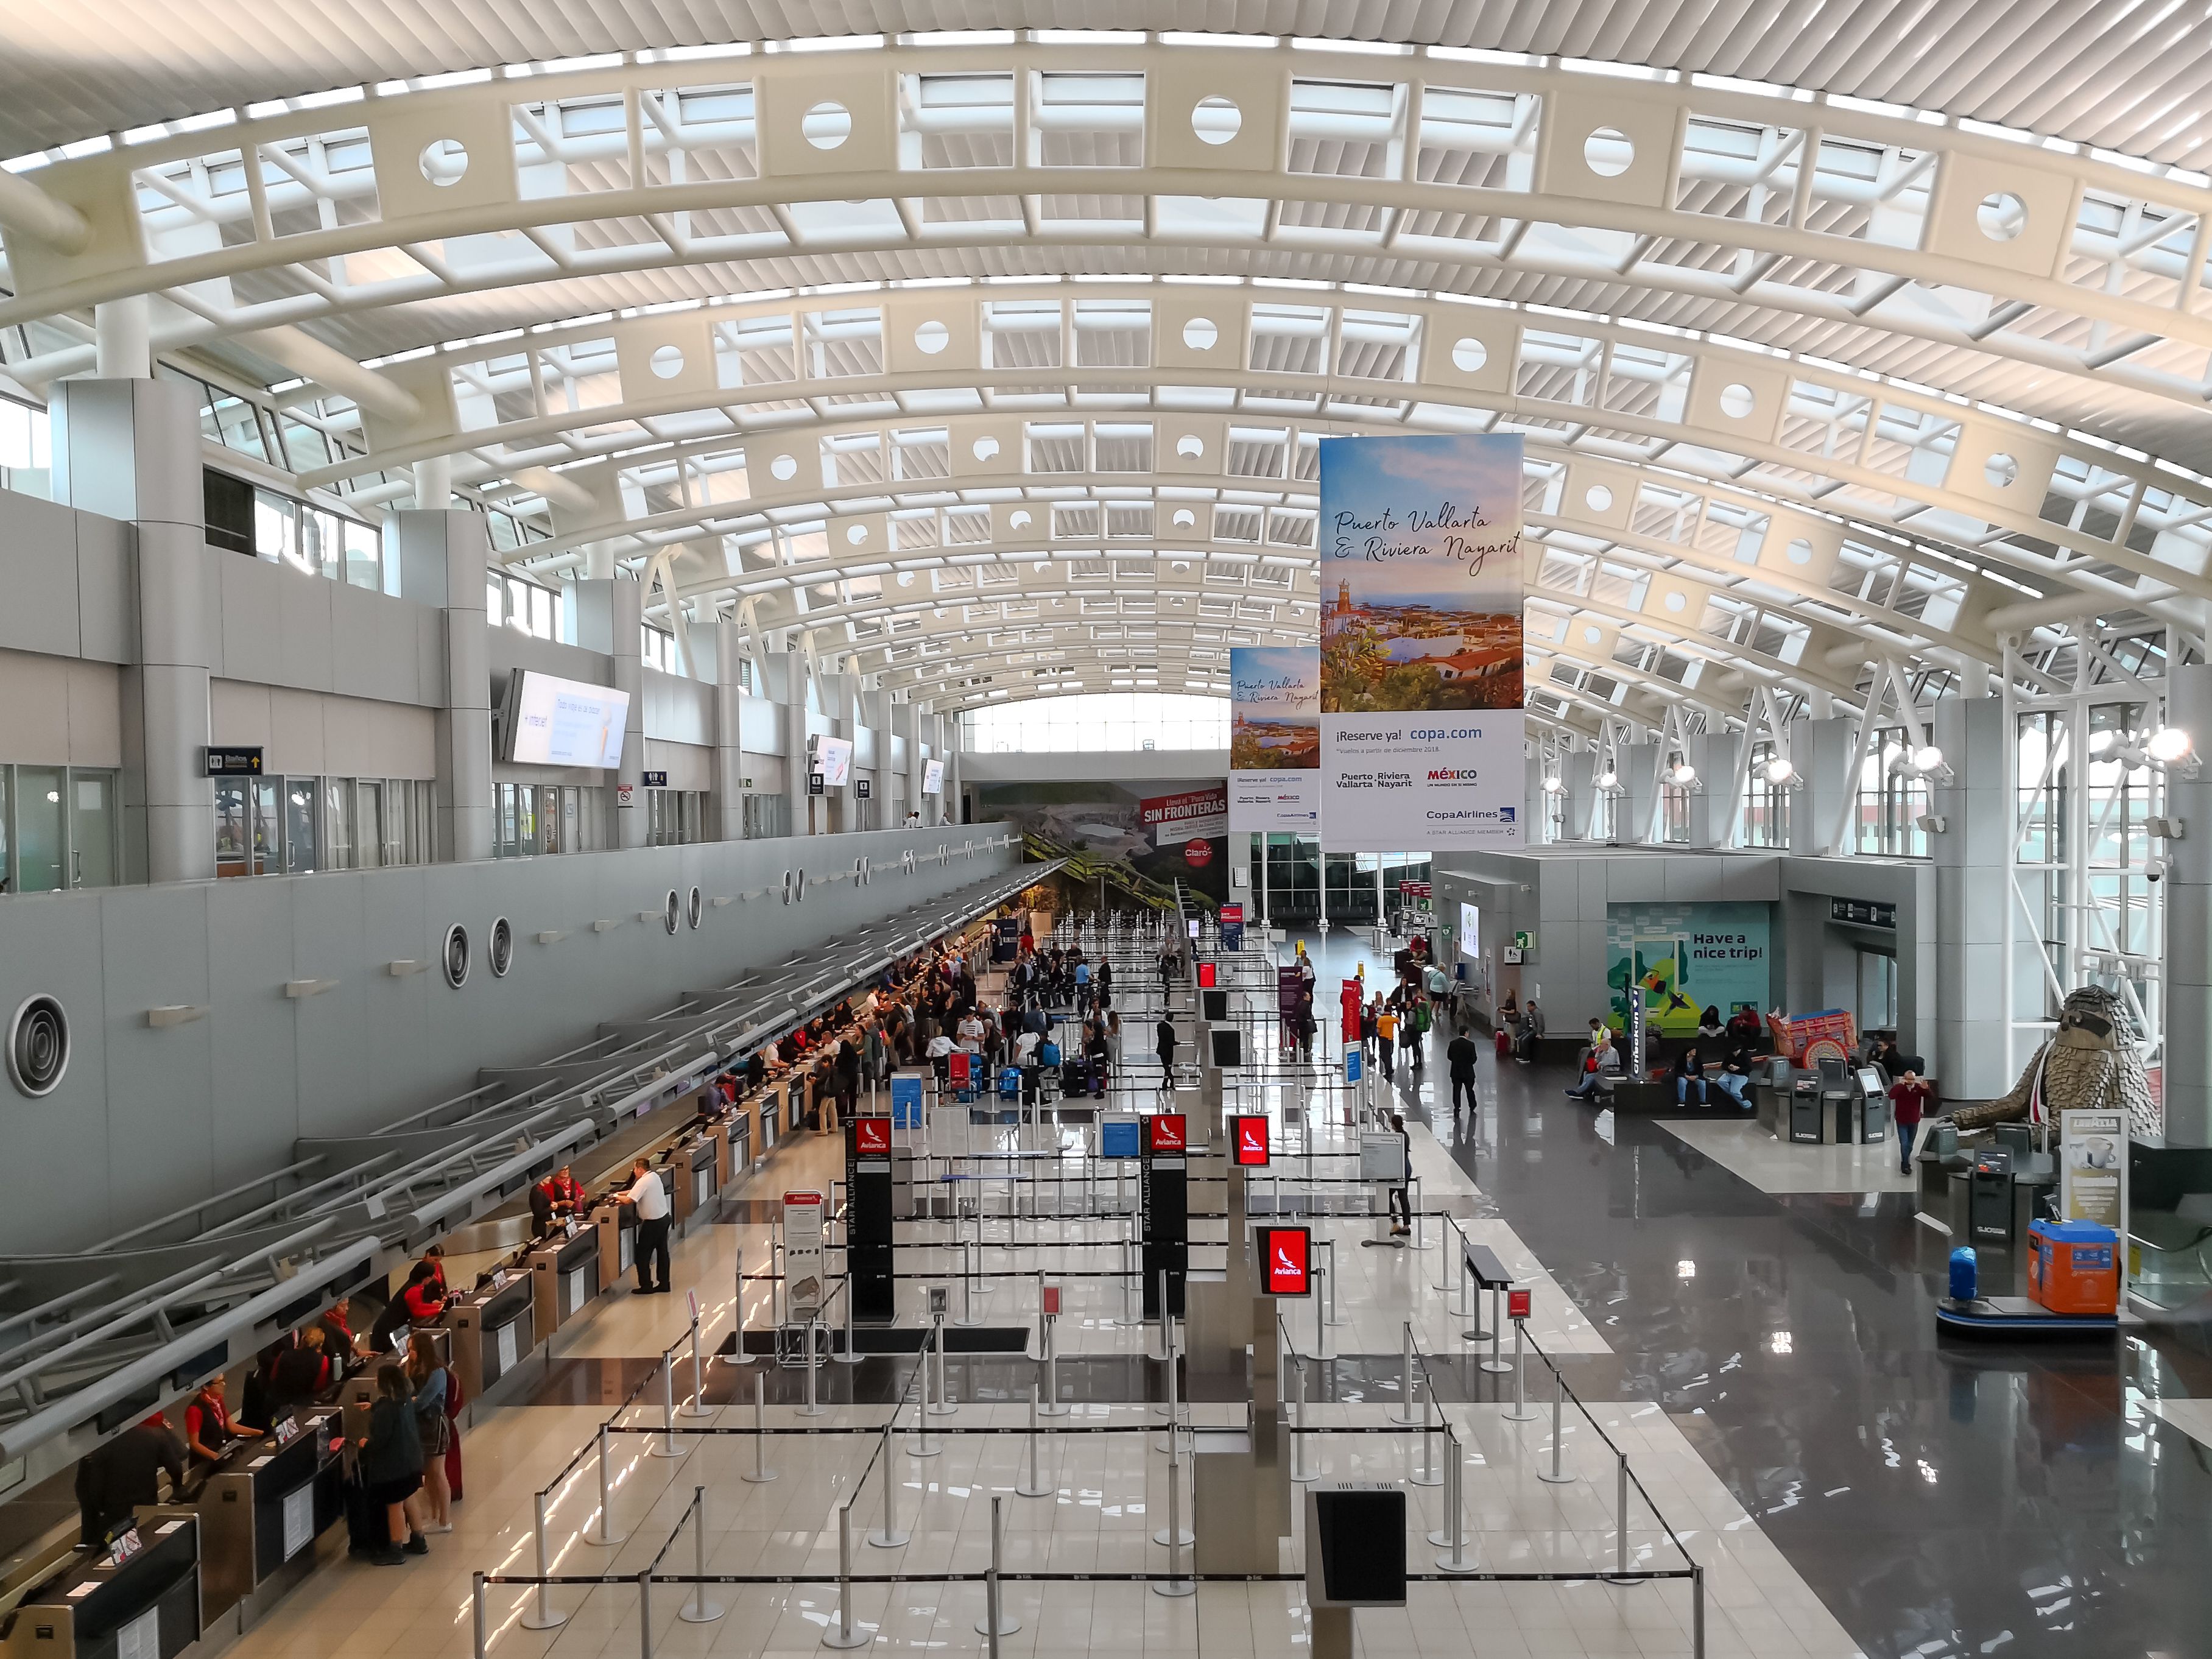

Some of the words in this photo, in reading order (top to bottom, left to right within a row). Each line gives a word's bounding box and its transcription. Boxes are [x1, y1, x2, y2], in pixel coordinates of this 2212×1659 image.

[1334, 507, 1400, 535] Puerto
[1407, 501, 1491, 532] Vallarta
[1334, 536, 1354, 558] &
[1364, 536, 1433, 562] Riviera
[1443, 530, 1521, 577] Nayarit
[1236, 678, 1266, 691] Puerto
[1269, 676, 1305, 691] Vallarta
[1249, 691, 1280, 703] Riviera
[1285, 689, 1319, 710] Nayarit
[1336, 731, 1383, 742] ¡Reserve
[1385, 729, 1401, 742] ya!
[1410, 728, 1482, 742] copa.com
[1336, 780, 1373, 789] Vallarta
[1377, 780, 1412, 789] Nayarit
[1144, 808, 1162, 822] SIN
[1164, 799, 1225, 820] FRONTERAS
[1694, 934, 1733, 944] Have
[1737, 934, 1745, 943] a
[1694, 946, 1726, 959] nice
[1729, 946, 1762, 960] trip!
